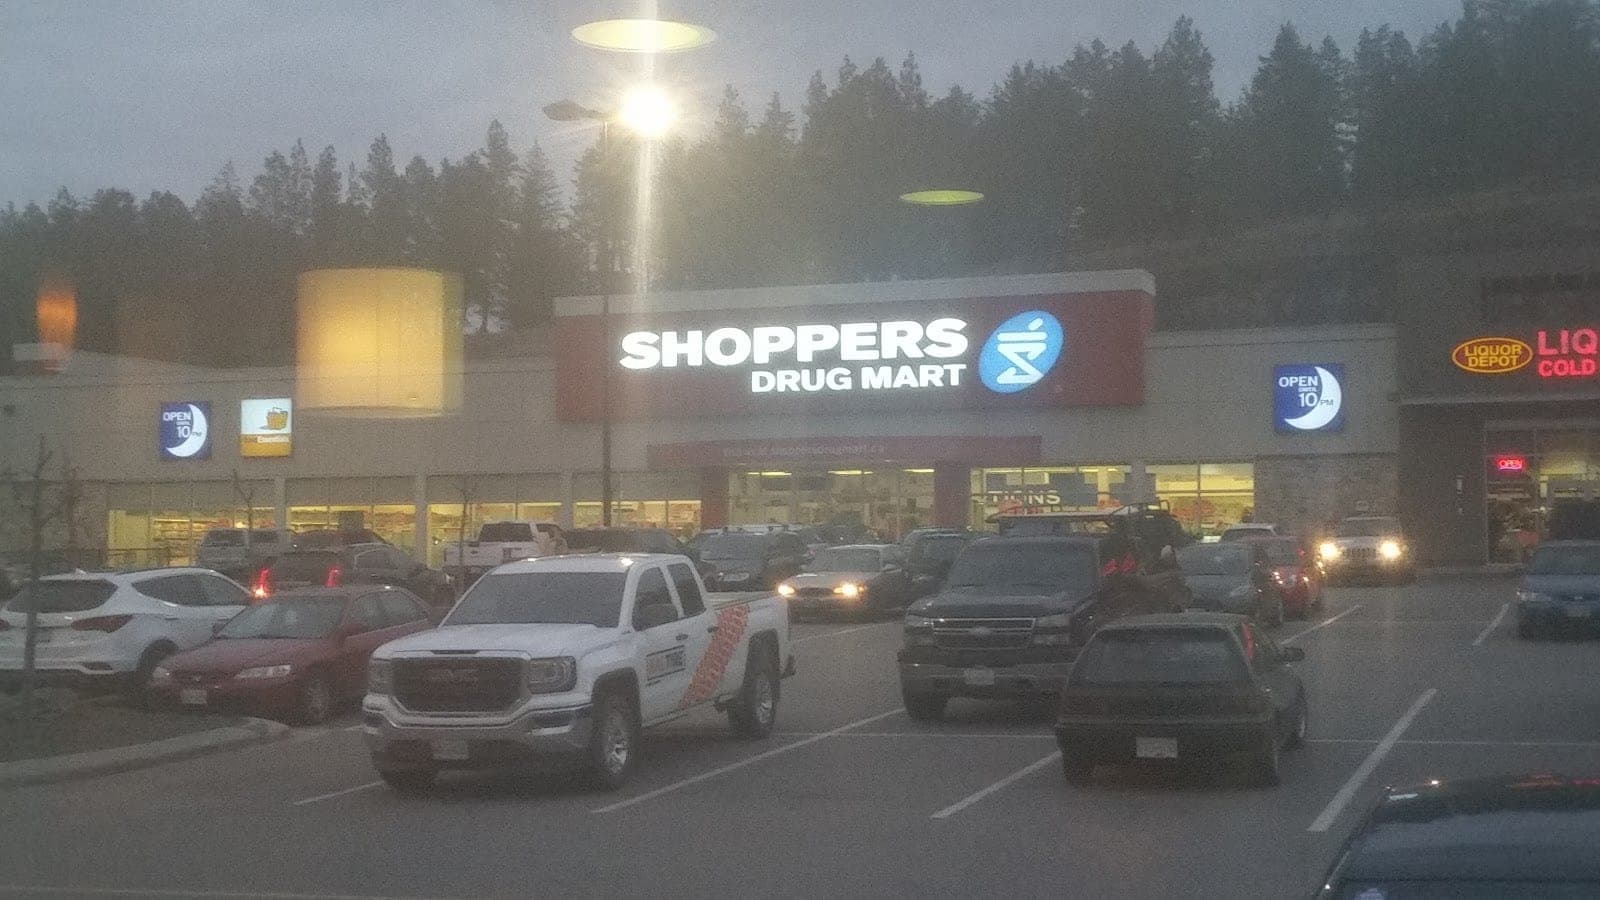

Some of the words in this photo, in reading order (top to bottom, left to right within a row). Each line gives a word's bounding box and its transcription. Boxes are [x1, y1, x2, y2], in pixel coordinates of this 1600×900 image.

[619, 317, 969, 369] SHOPPERS
[1537, 328, 1599, 356] LIQ
[1464, 344, 1522, 358] LIQUOR
[1467, 355, 1519, 368] DEPOT
[1538, 359, 1596, 378] COLD
[751, 367, 853, 393] DRUG
[861, 363, 967, 390] MART
[1278, 375, 1319, 388] OPEN
[1298, 392, 1319, 408] 10
[163, 411, 191, 422] OPEN
[176, 426, 191, 438] 10
[1499, 459, 1524, 470] OPEN
